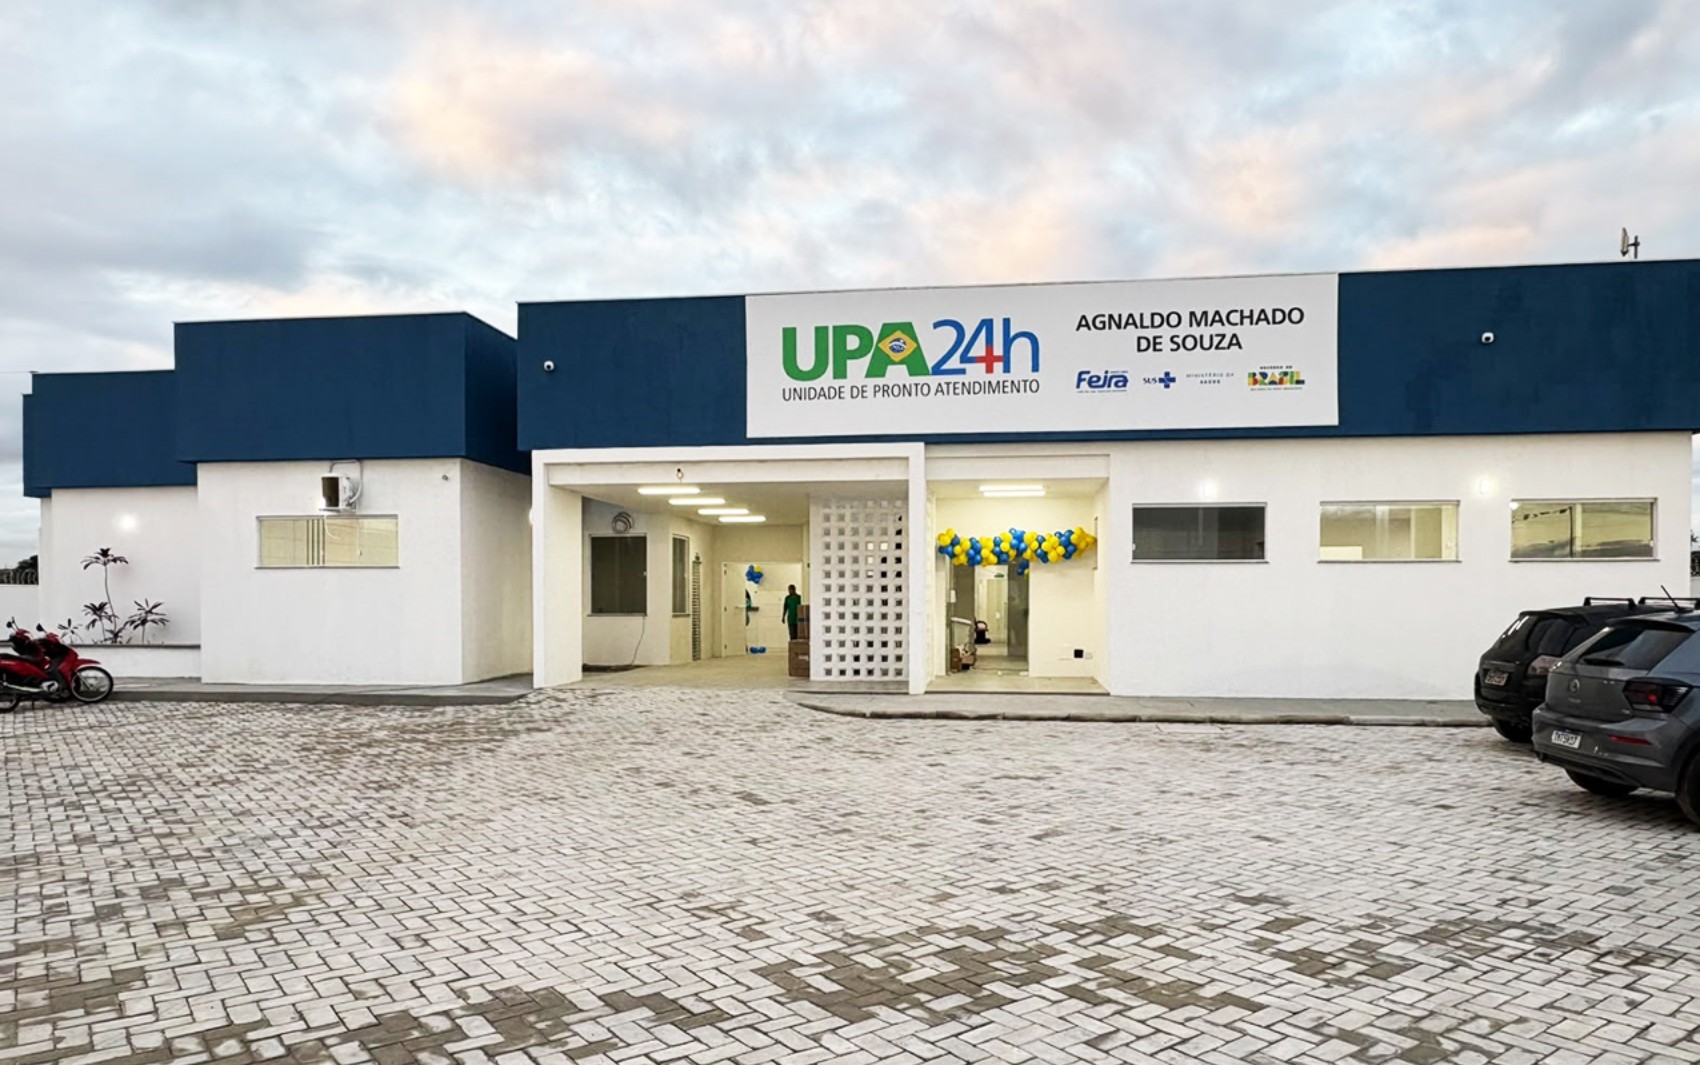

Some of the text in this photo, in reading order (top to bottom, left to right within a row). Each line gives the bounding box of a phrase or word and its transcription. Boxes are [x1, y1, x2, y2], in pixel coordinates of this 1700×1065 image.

[1076, 307, 1305, 331] AGNALDO MACHADO
[782, 322, 930, 382] UPA
[1137, 333, 1243, 353] DE SOUZA
[1076, 370, 1129, 389] Feira
[1248, 371, 1305, 386] BRASIL
[782, 379, 1040, 402] UNIDADE DE PRONTO ATENDIMENTO
